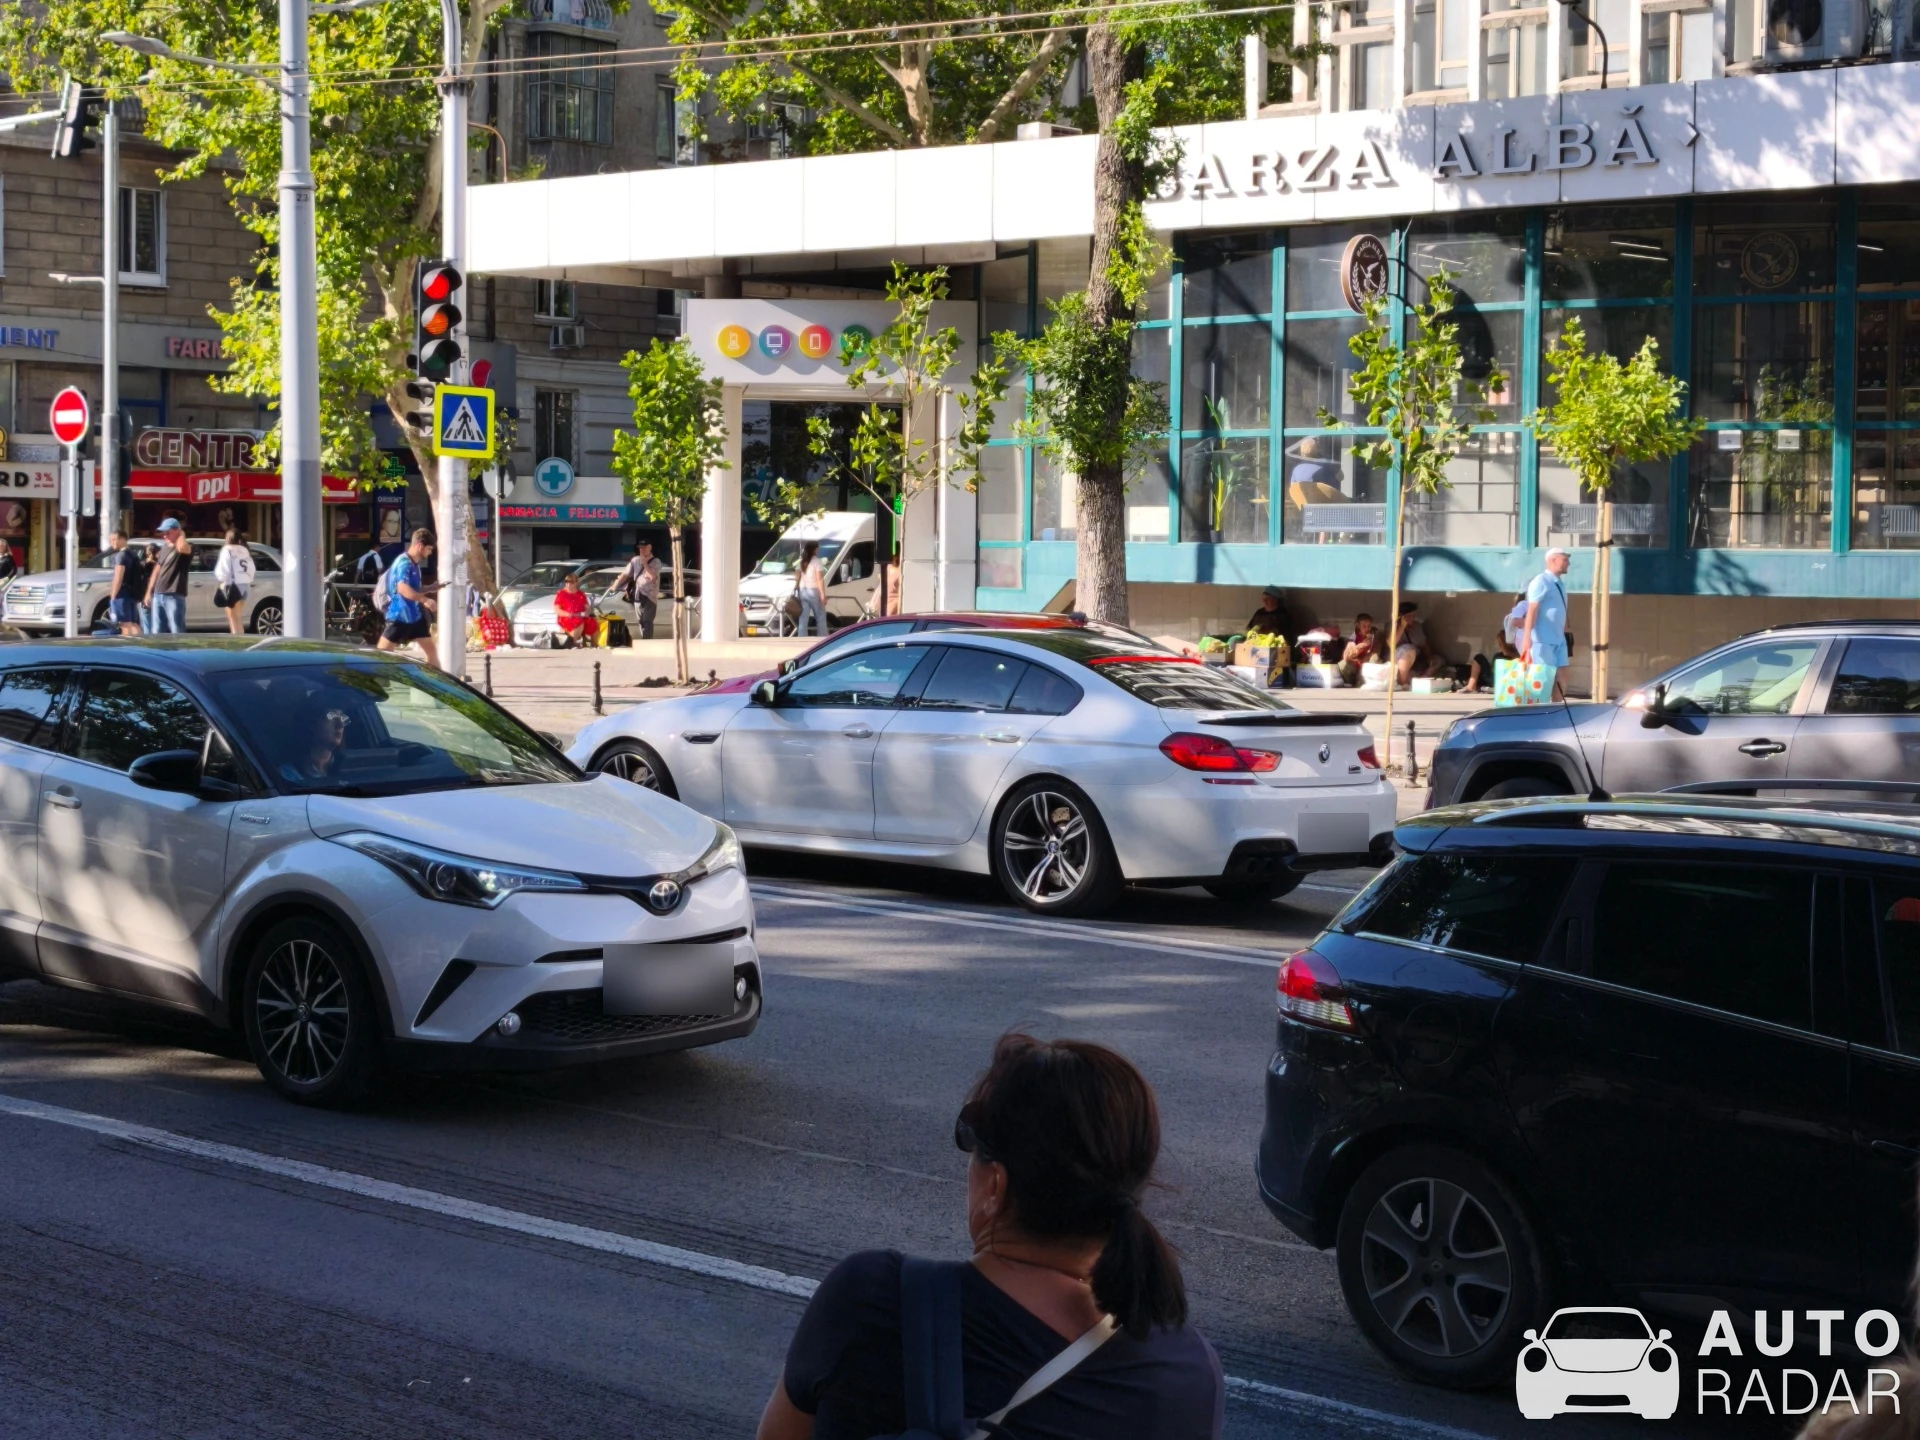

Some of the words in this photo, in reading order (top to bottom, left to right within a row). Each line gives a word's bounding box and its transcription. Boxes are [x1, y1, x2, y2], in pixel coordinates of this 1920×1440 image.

[1433, 105, 1660, 179] ALBĂ
[137, 430, 280, 469] CENTR
[198, 474, 231, 500] ppt
[568, 507, 619, 519] FELICIA
